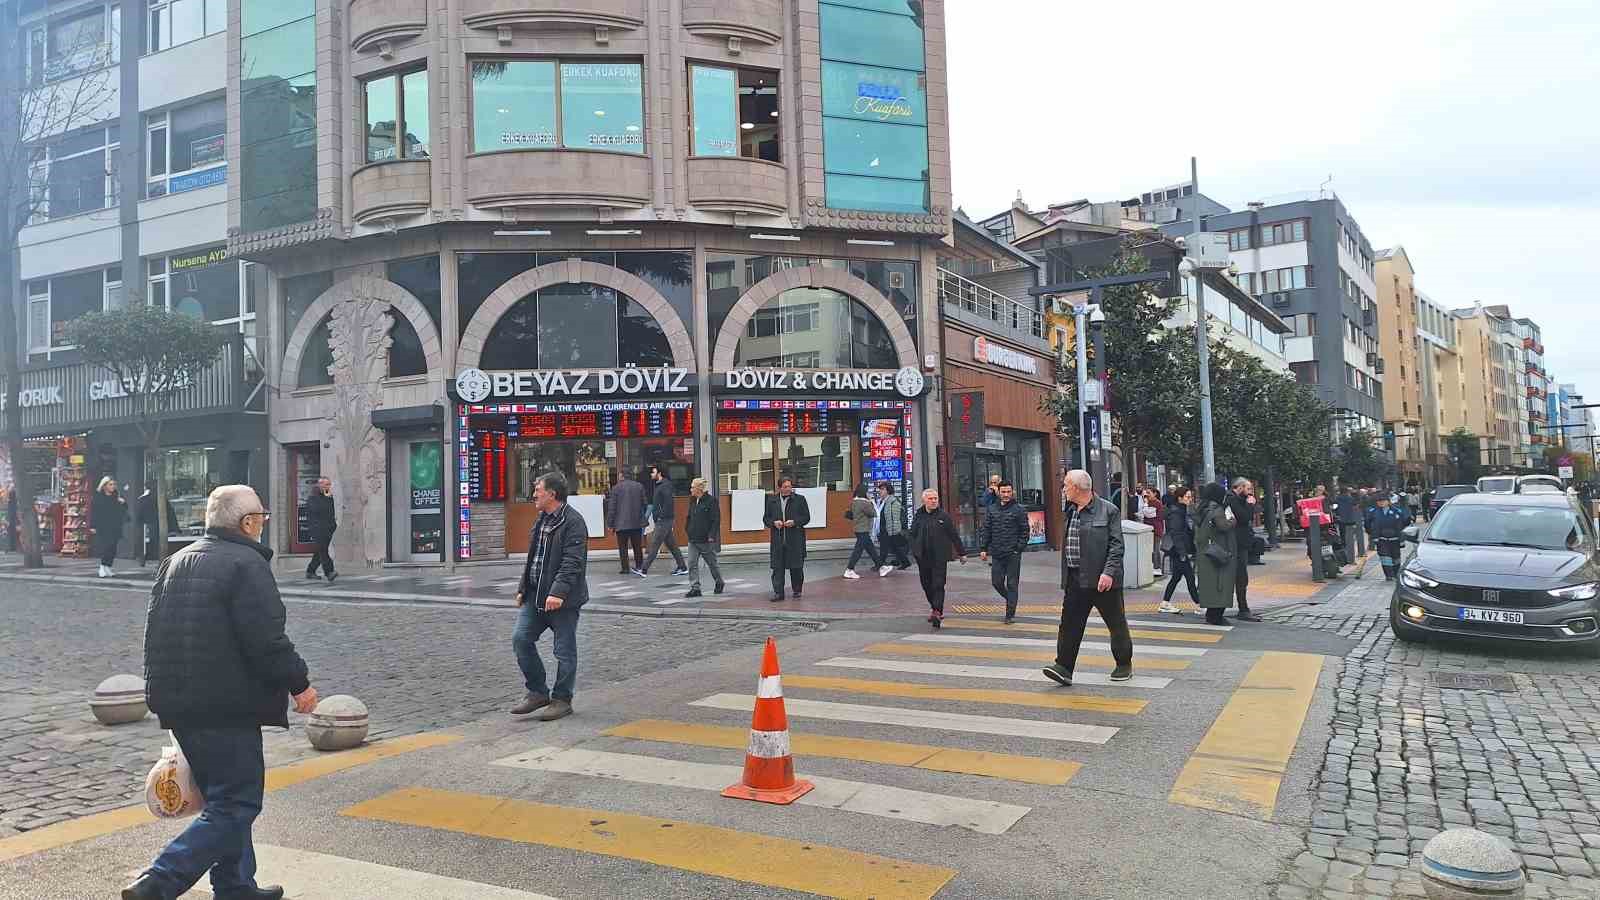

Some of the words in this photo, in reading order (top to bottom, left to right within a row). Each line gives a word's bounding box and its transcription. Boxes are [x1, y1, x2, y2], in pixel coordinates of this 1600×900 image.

[493, 370, 590, 397] BEYAZ
[598, 363, 689, 394] DÖVİZ
[725, 367, 788, 389] DÖVİZ
[793, 371, 807, 390] &
[812, 371, 894, 390] CHANGE
[543, 404, 556, 412] ALL
[558, 404, 572, 412] THE
[574, 403, 602, 412] WORLD
[603, 402, 648, 411] CURRENCIES
[650, 402, 664, 410] ARE
[666, 401, 693, 409] ACCEPT
[413, 489, 440, 498] CHANGE
[415, 497, 440, 505] OFFICE
[1482, 589, 1500, 602] FIAT
[1464, 608, 1476, 619] 34
[1502, 611, 1521, 623] 960
